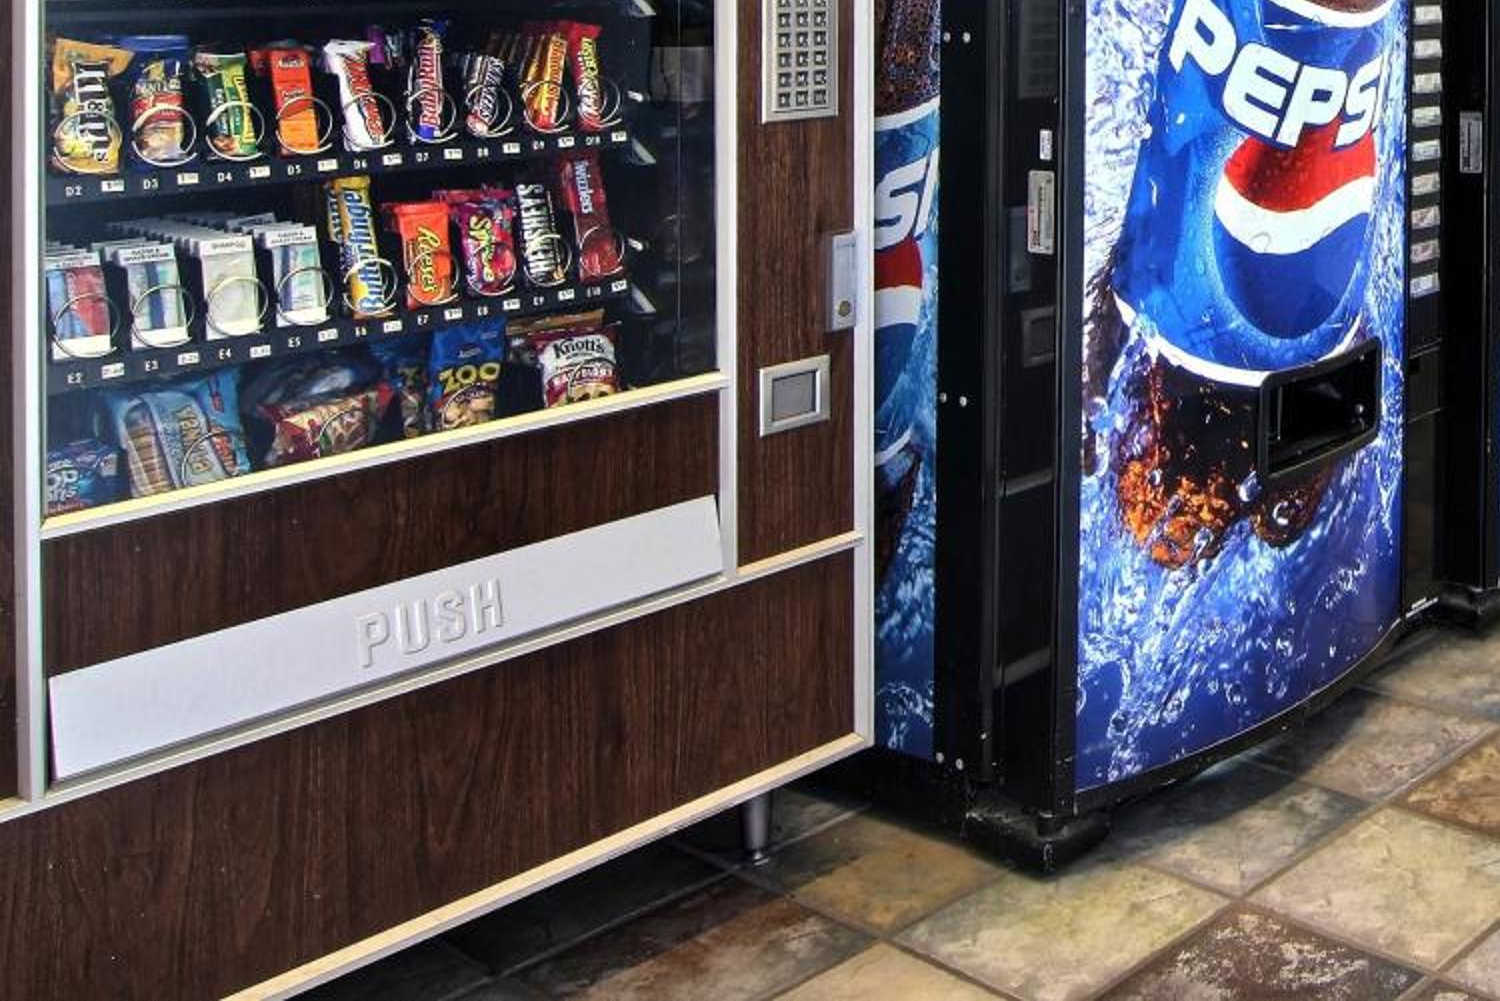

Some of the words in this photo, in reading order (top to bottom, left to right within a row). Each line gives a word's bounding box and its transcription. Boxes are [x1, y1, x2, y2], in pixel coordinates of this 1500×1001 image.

[219, 348, 231, 360] E4
[439, 362, 499, 392] ZOO
[354, 578, 504, 668] PUSH
